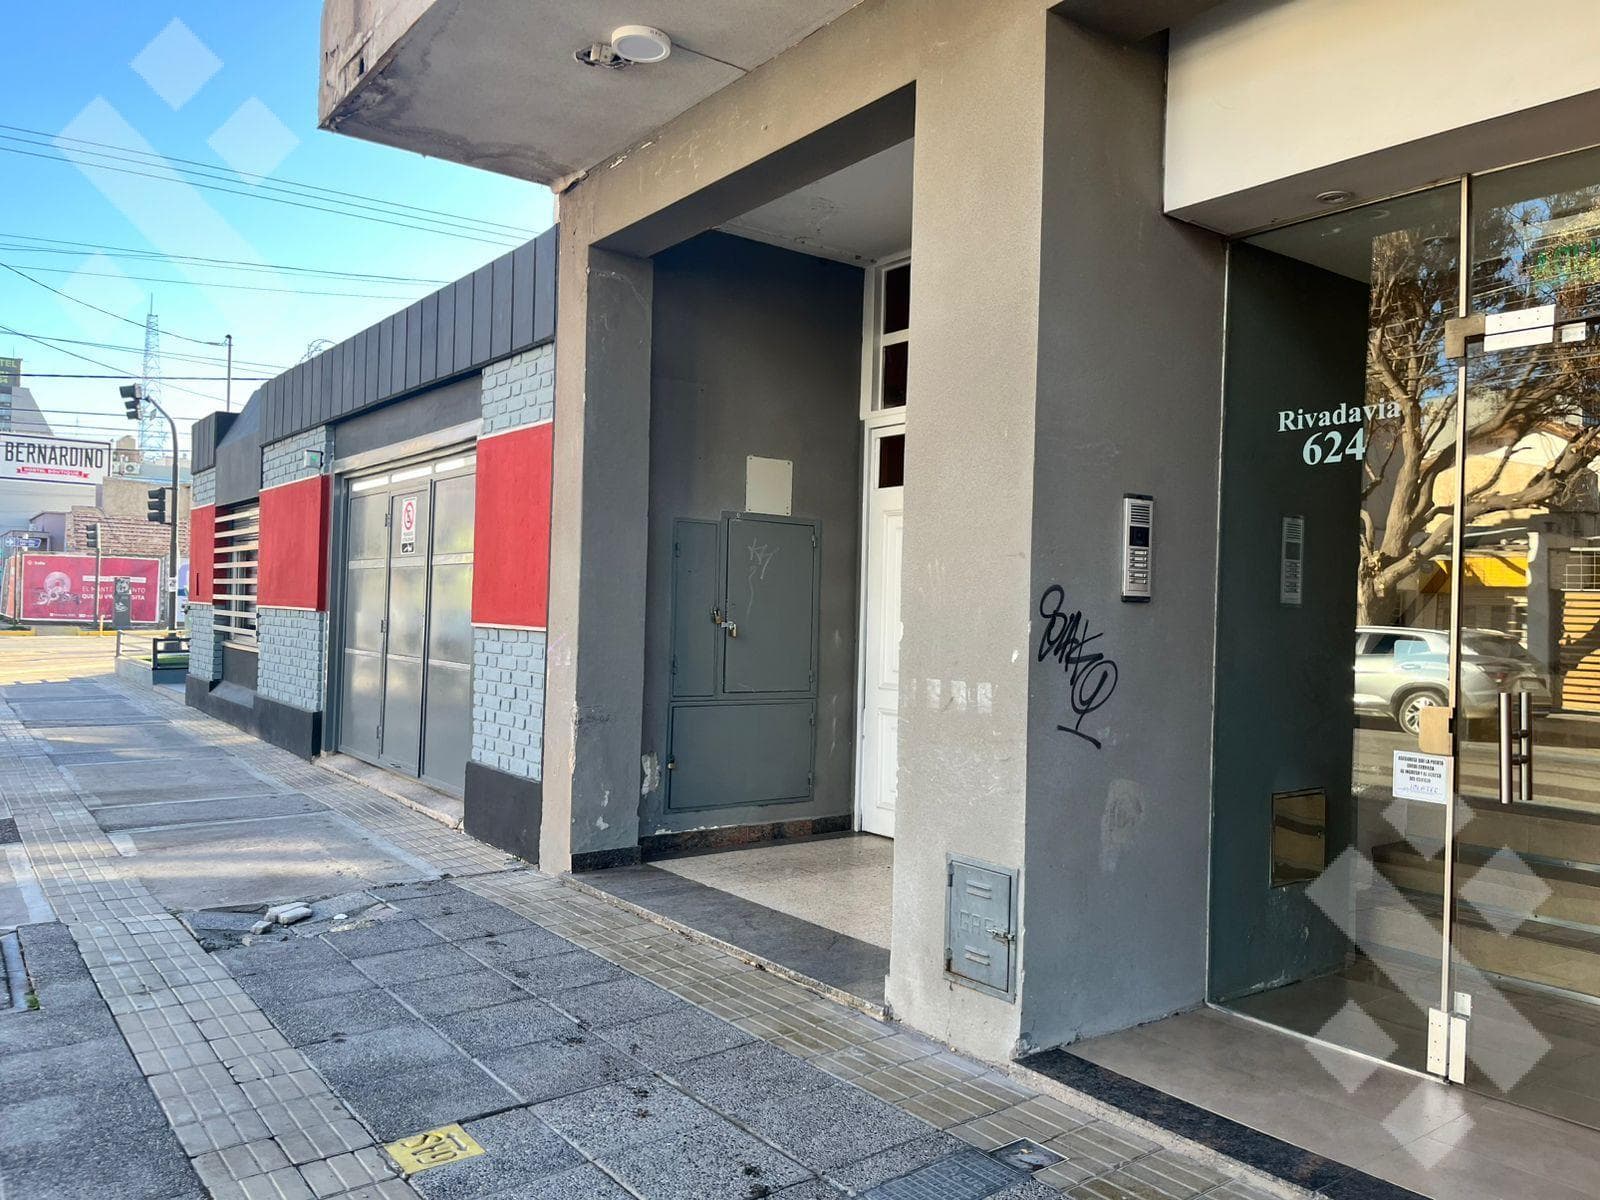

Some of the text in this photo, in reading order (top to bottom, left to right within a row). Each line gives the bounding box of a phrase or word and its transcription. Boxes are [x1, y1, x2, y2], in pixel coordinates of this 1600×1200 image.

[1277, 398, 1402, 432] Rivadavia
[5, 442, 104, 468] BERNARDINO
[1302, 427, 1366, 466] 624
